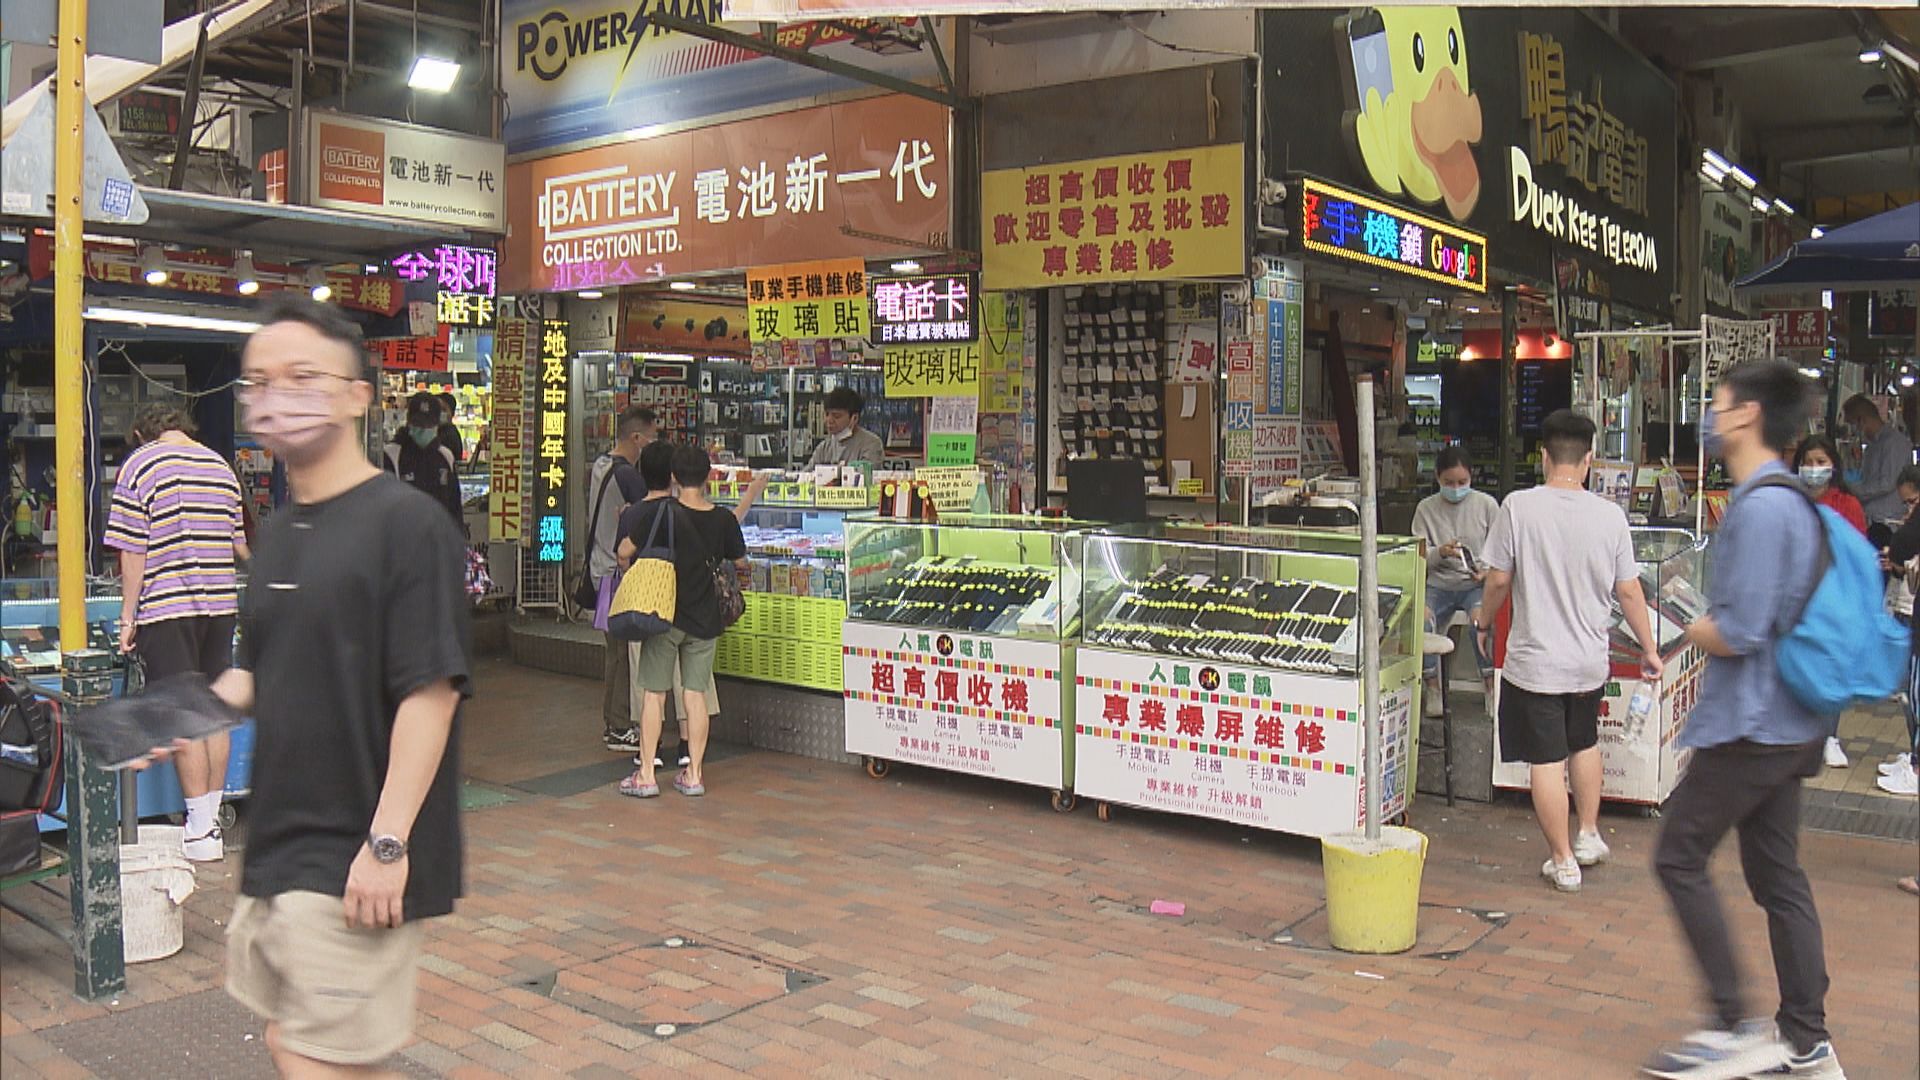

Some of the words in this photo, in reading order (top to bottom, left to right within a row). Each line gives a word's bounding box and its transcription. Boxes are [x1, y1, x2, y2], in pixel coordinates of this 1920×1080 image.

[324, 172, 367, 187] COLLECTION
[328, 150, 380, 170] BATTERY
[390, 156, 495, 193] 電池新一代
[551, 170, 676, 228] BATTERY
[694, 140, 937, 225] 電池新一代
[388, 199, 495, 220] www.batterycollection.com
[993, 194, 1230, 246] 歡迎零售及批發
[1567, 198, 1598, 251] KEE
[543, 232, 642, 267] COLLECTION
[646, 228, 682, 255] LTD.
[1042, 237, 1174, 278] 專業維修
[1431, 234, 1476, 281] Google
[749, 270, 864, 302] 專業手機維修
[874, 279, 968, 321] 電話卡
[438, 293, 494, 326] 話卡
[755, 300, 860, 338] 玻璃貼
[886, 346, 979, 387] 玻璃貼
[1229, 344, 1252, 458] 高價收機
[492, 320, 526, 537] 精藝電話卡
[871, 661, 1029, 713] 超高價收機
[885, 722, 908, 733] Mobile
[934, 730, 961, 742] Camera
[981, 736, 1018, 750] Notebook
[936, 715, 959, 731] 相機
[1102, 694, 1326, 755] 專業爆屏維修
[900, 735, 940, 753] 專業維修
[1116, 744, 1170, 766] 手提電話
[1194, 756, 1223, 773] 相機
[1247, 764, 1307, 788] 手提電腦
[1128, 761, 1158, 775] Mobile
[1191, 772, 1225, 786] Camera
[1251, 781, 1298, 798] Notebook
[1139, 791, 1194, 811] Professional
[1196, 801, 1223, 817] repair
[1236, 808, 1270, 823] mobile
[1146, 778, 1198, 800] 專業維修
